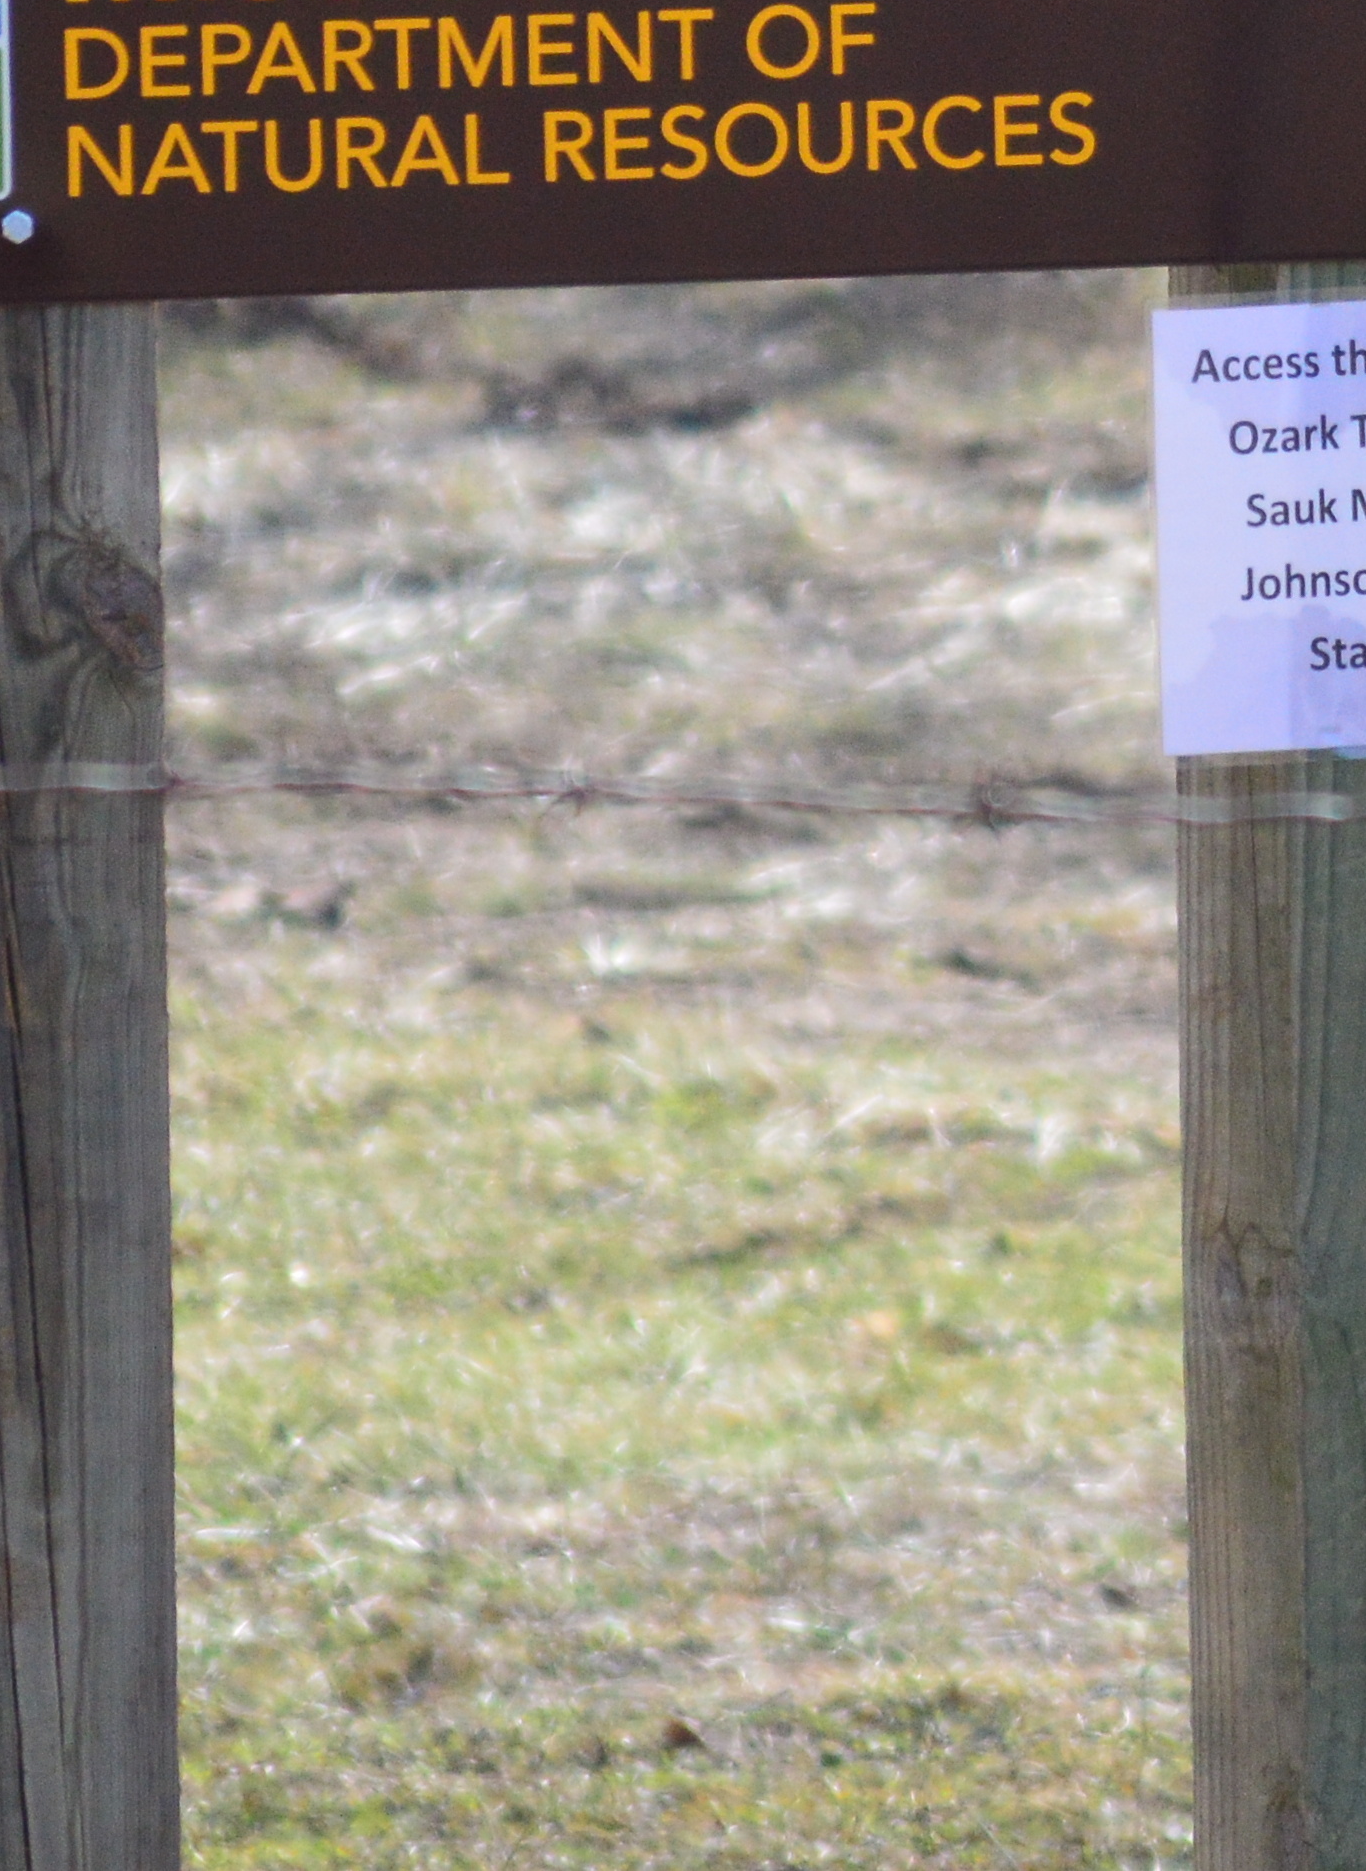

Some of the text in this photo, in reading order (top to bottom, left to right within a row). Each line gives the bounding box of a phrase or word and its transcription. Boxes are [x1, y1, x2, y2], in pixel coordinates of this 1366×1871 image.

[63, 2, 878, 100] DEPARTMENT OF
[67, 91, 1097, 198] NATURAL RESOURCES
[1191, 348, 1320, 384] Access
[1229, 415, 1340, 454] Ozark
[1246, 490, 1337, 527] Sauk
